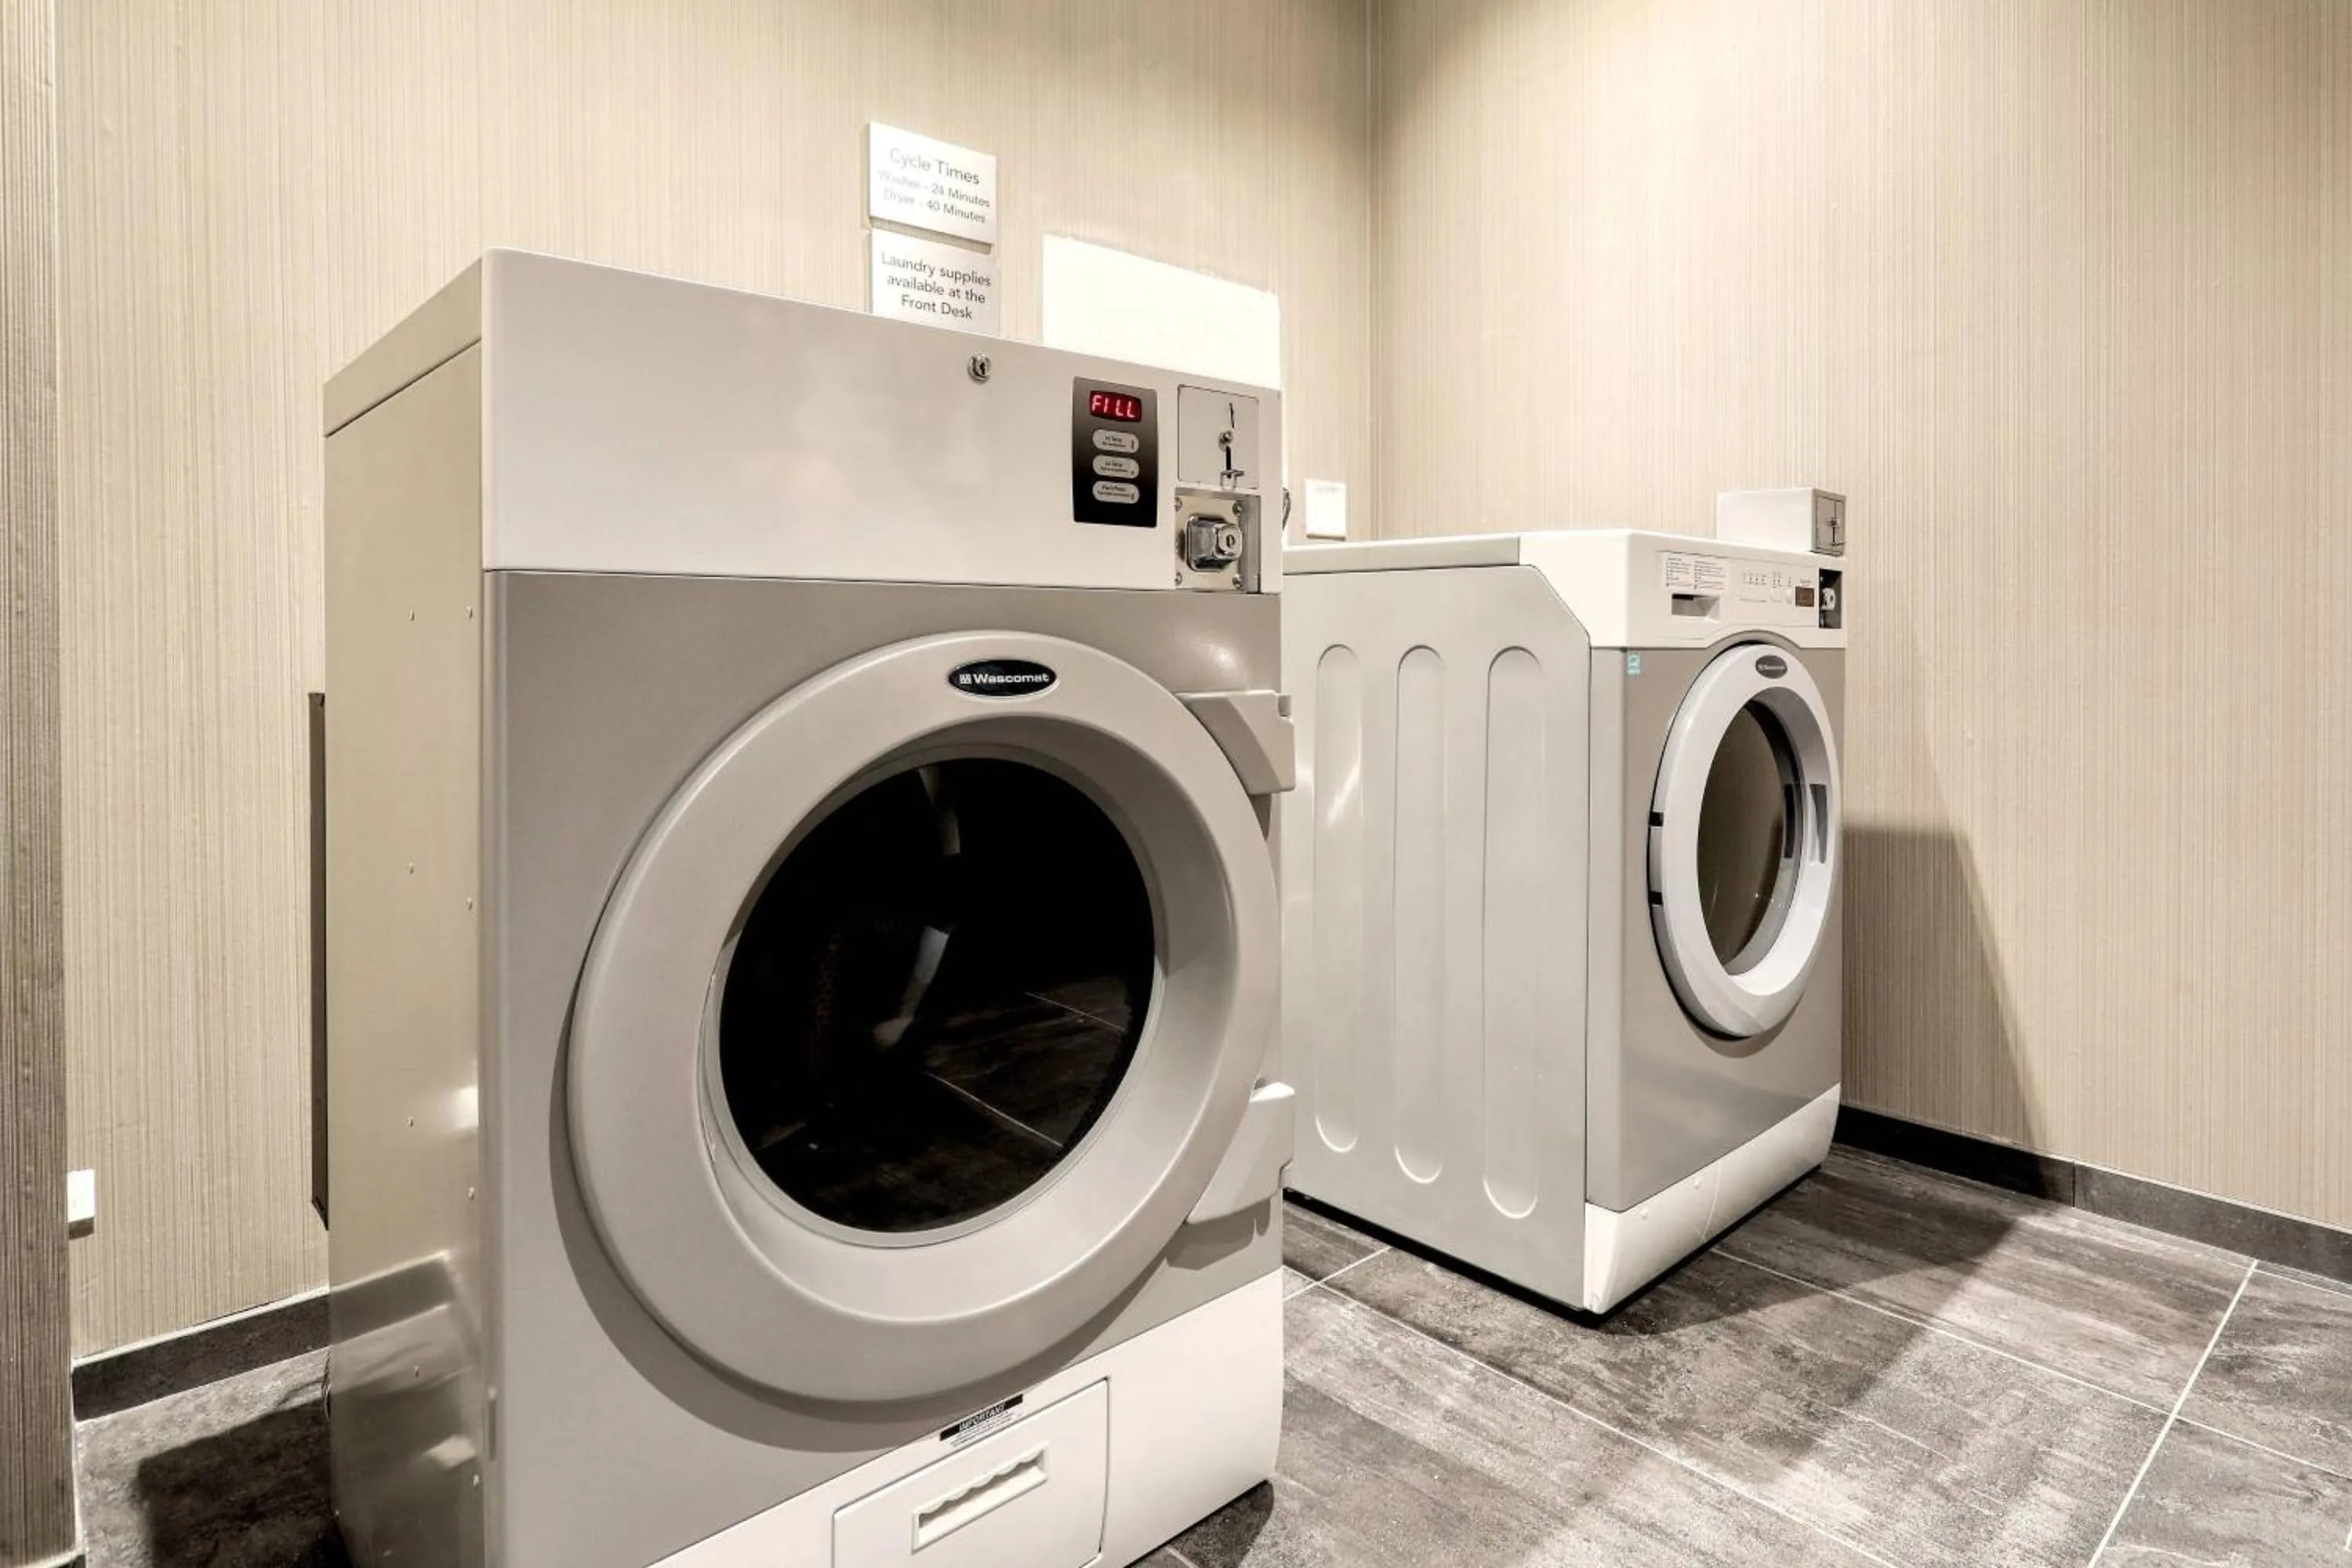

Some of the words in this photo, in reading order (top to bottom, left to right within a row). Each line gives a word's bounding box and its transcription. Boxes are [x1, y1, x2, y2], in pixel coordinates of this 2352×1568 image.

[890, 147, 931, 172] Cycle
[935, 158, 979, 184] Times
[883, 187, 915, 206] Dryer
[926, 199, 941, 212] 40
[943, 203, 985, 223] Minutes
[948, 187, 991, 208] Minutes
[881, 251, 935, 276] Laundry
[940, 267, 992, 288] supplies
[887, 275, 944, 295] available
[948, 286, 961, 299] at
[965, 289, 985, 304] the
[901, 294, 937, 313] Front
[941, 302, 973, 320] Desk
[1091, 394, 1135, 418] FILL
[972, 673, 1050, 684] Wascomat
